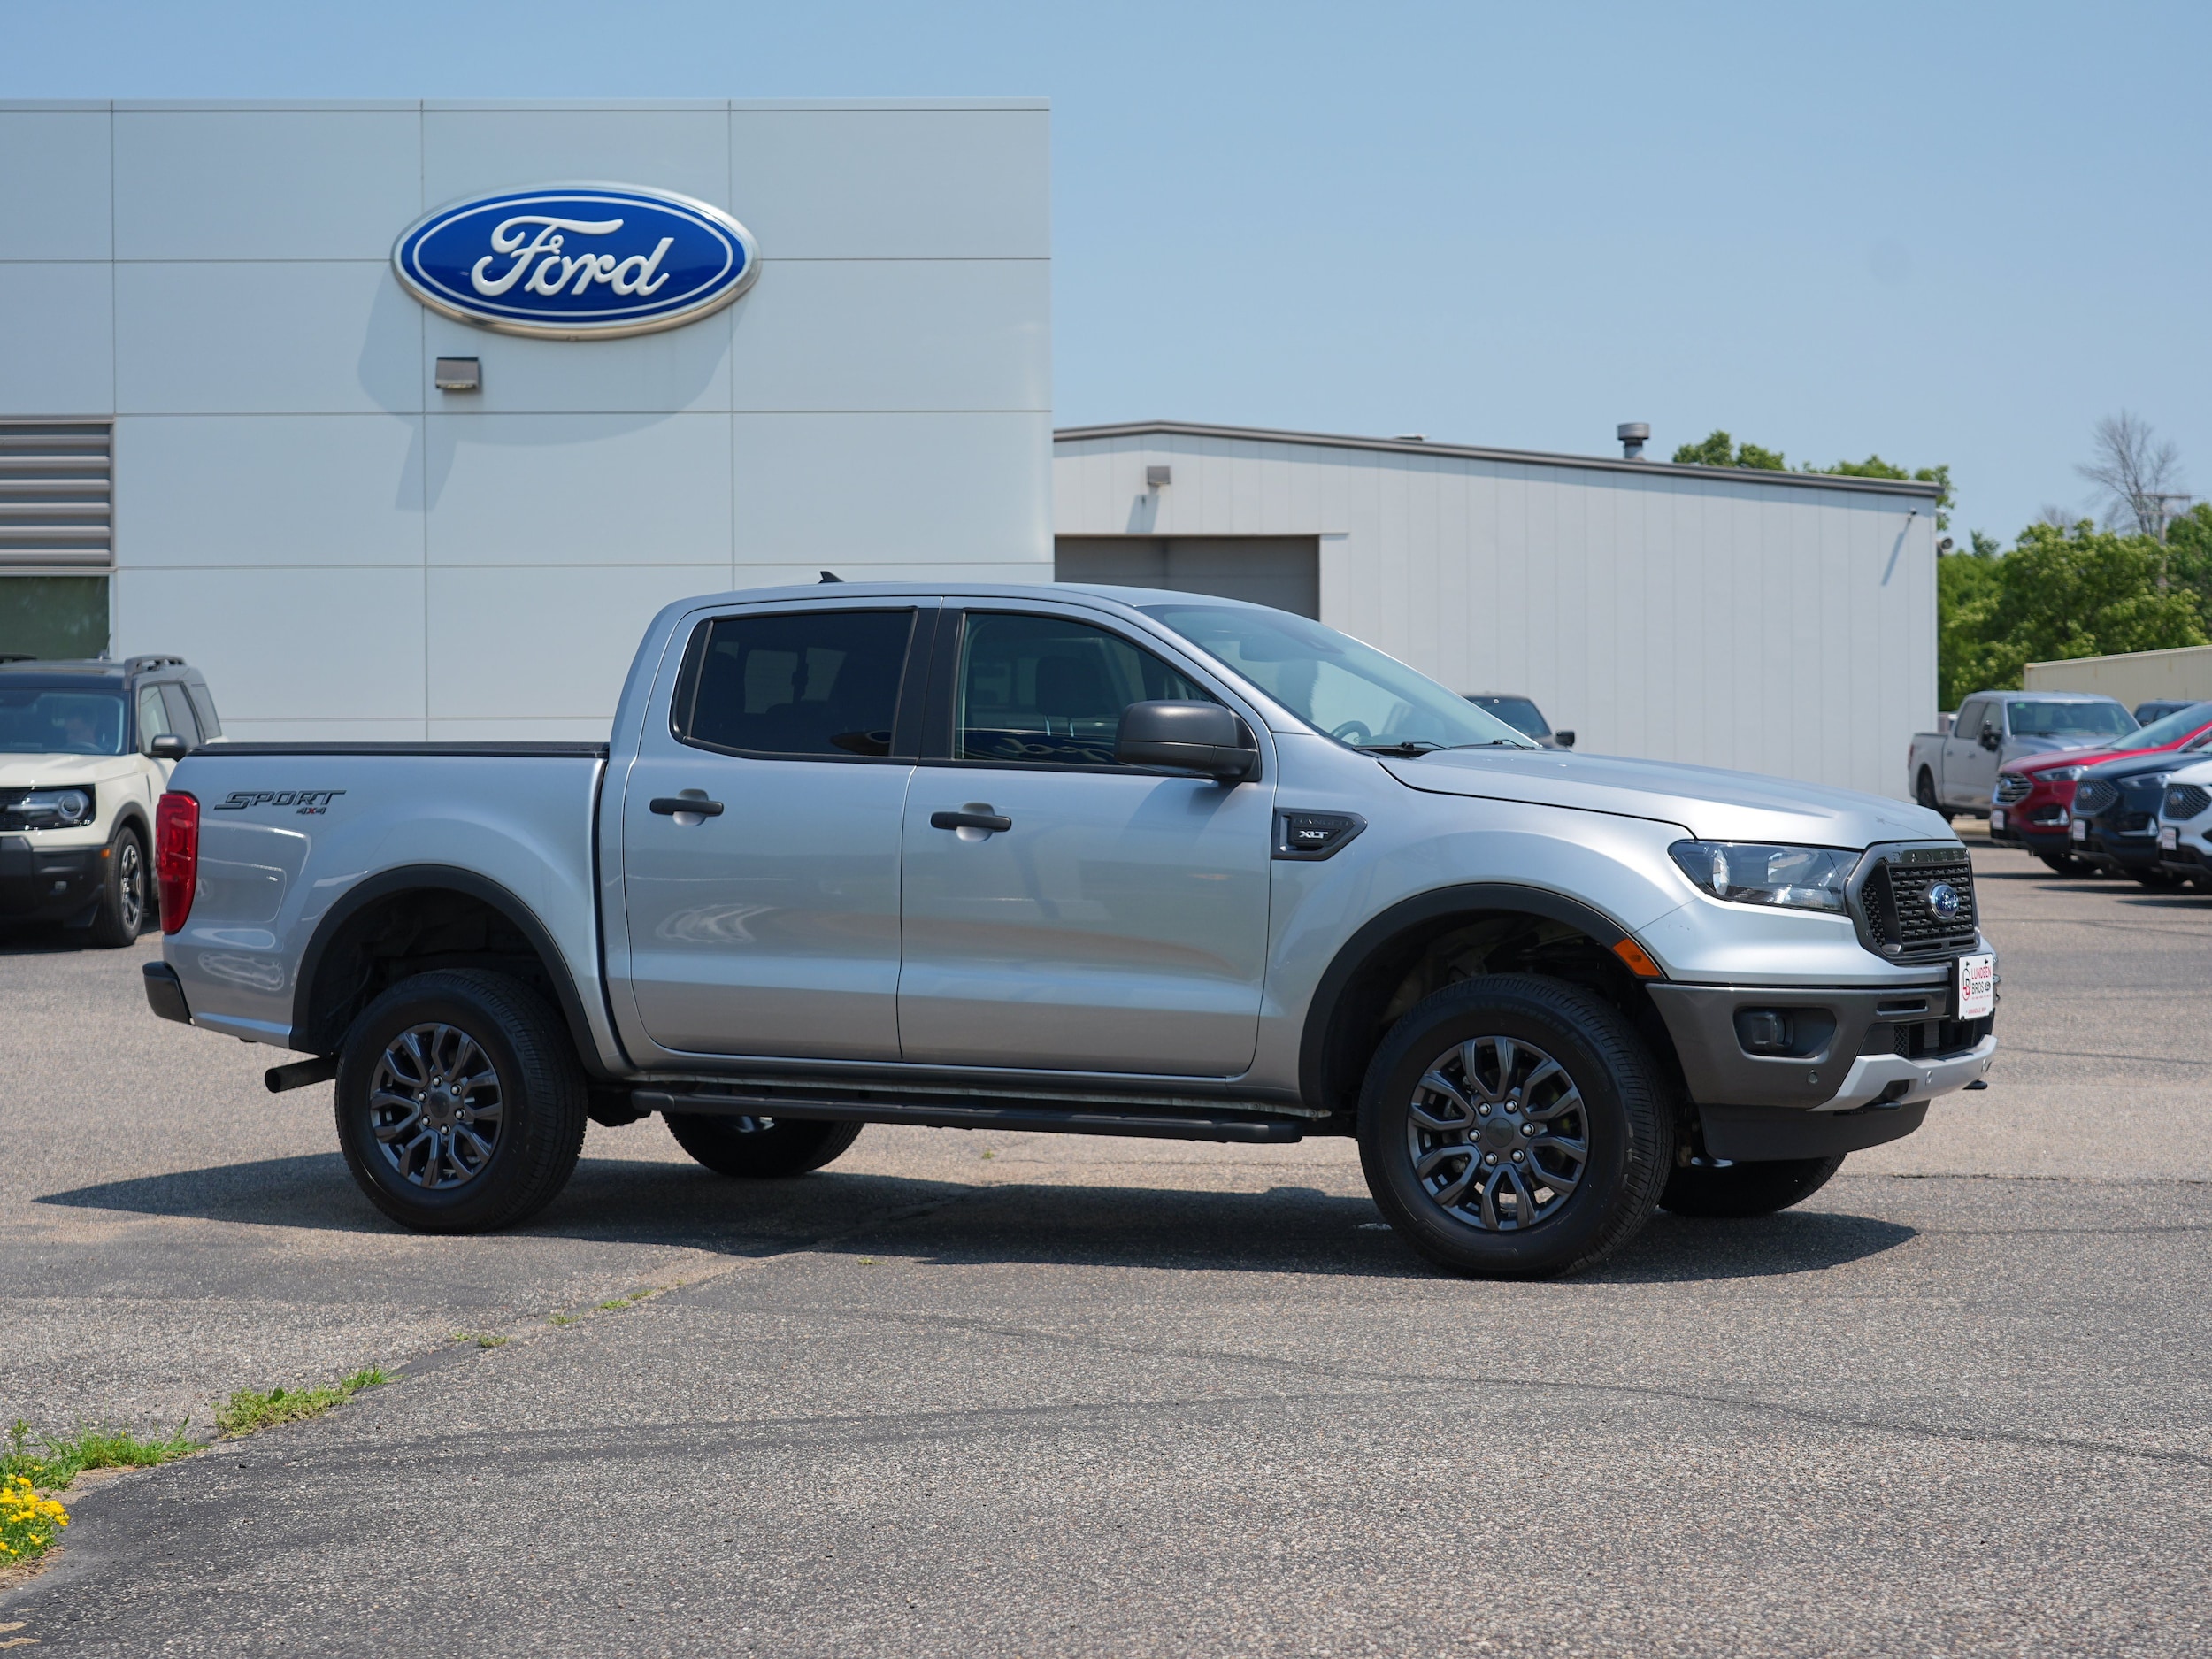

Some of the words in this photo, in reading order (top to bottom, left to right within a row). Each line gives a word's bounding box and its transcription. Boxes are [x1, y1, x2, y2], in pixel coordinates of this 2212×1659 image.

[471, 215, 674, 296] Ford
[213, 789, 347, 810] SPORT
[1298, 830, 1329, 839] XLT
[1971, 966, 1992, 979] LUNDEEN
[1971, 981, 1984, 994] BROS
